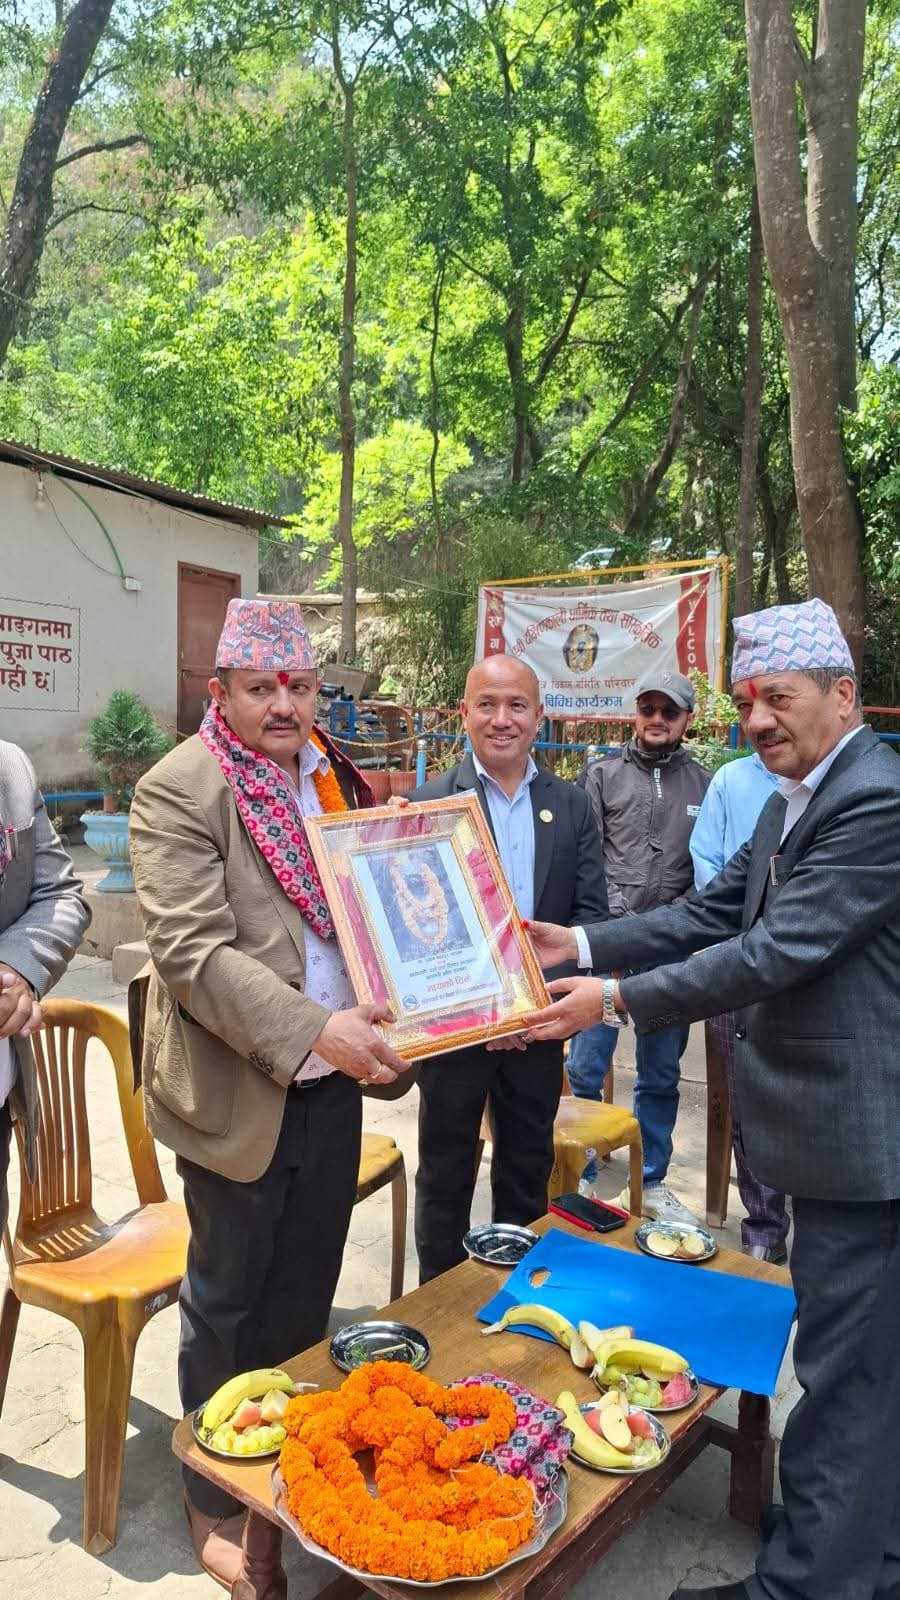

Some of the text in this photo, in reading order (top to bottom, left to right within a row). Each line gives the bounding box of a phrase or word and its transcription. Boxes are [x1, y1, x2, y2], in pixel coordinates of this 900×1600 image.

[599, 607, 618, 624] तथा
[686, 599, 698, 671] WELCO
[37, 644, 73, 664] पाठ
[604, 676, 637, 689] परिवार
[544, 693, 624, 708] विविध कार्यक्रम
